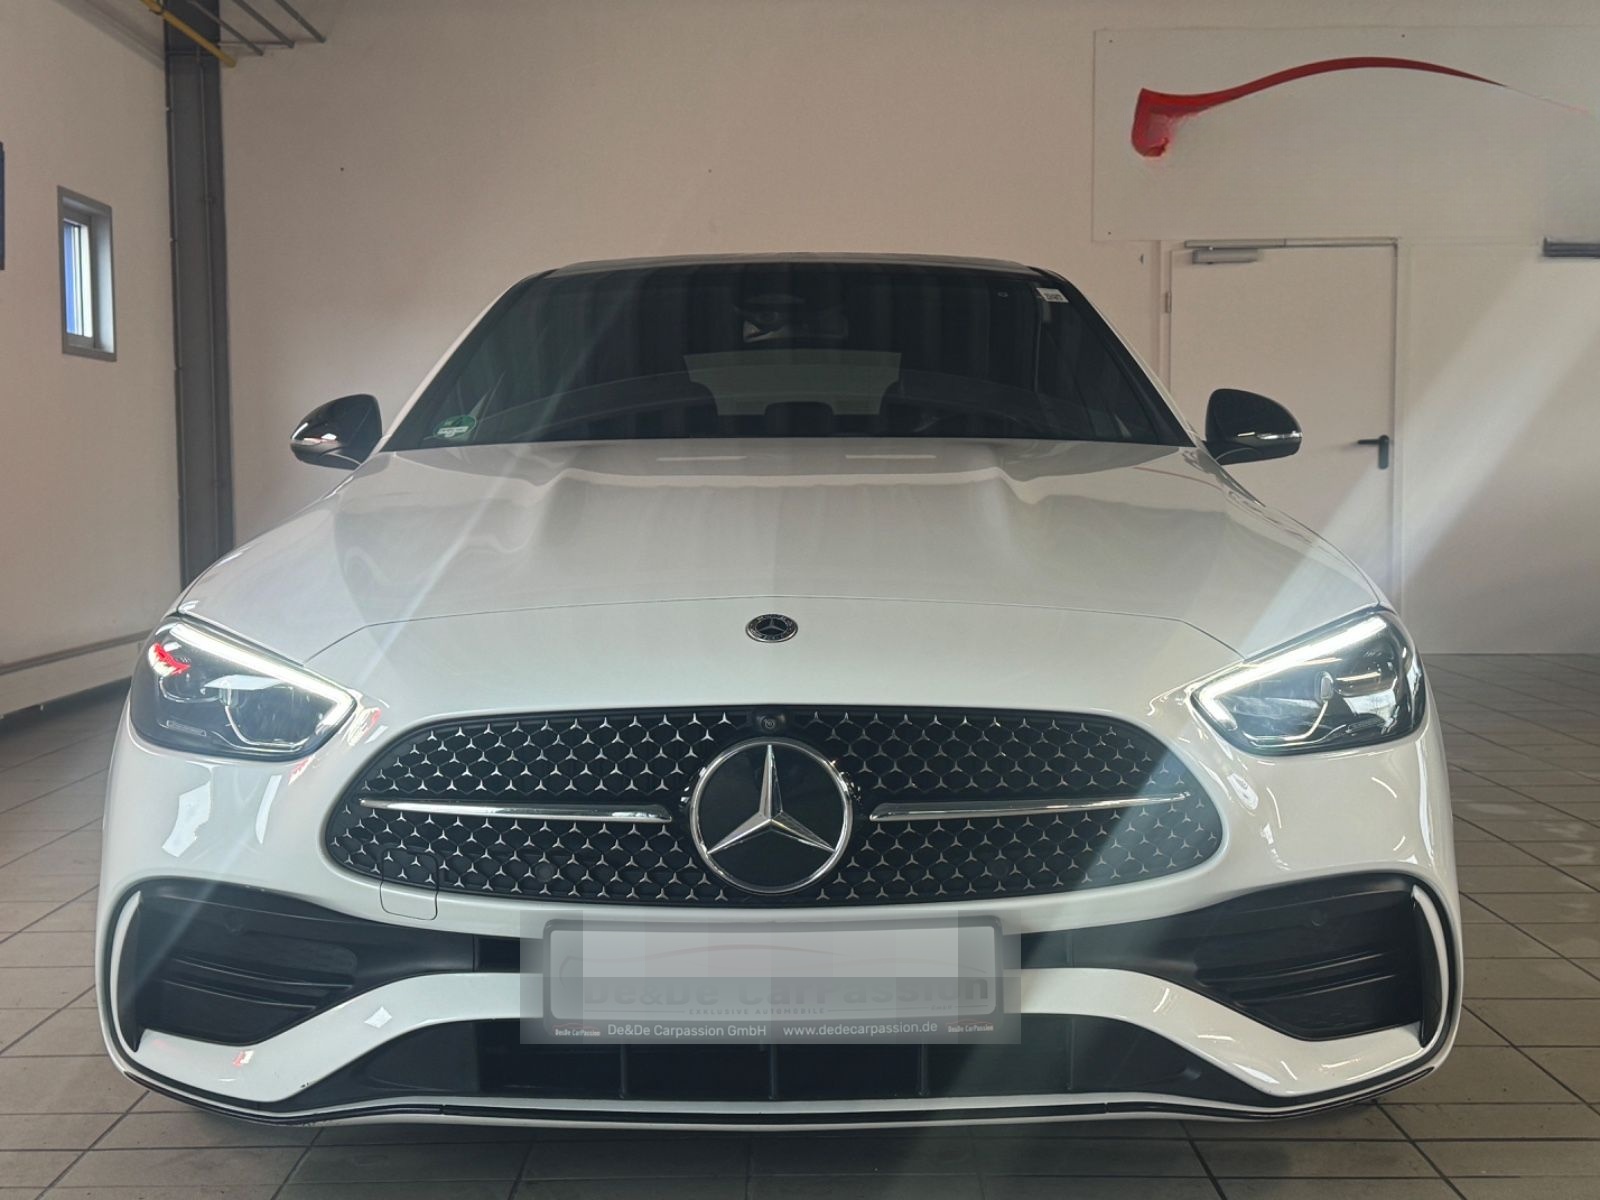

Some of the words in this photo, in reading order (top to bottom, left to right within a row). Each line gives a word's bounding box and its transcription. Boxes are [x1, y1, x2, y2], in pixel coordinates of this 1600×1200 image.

[607, 1024, 651, 1036] De&De
[653, 1023, 724, 1039] Carpassion
[727, 1024, 767, 1037] GmbH
[782, 1020, 938, 1037] www.dedecarpassion.de
